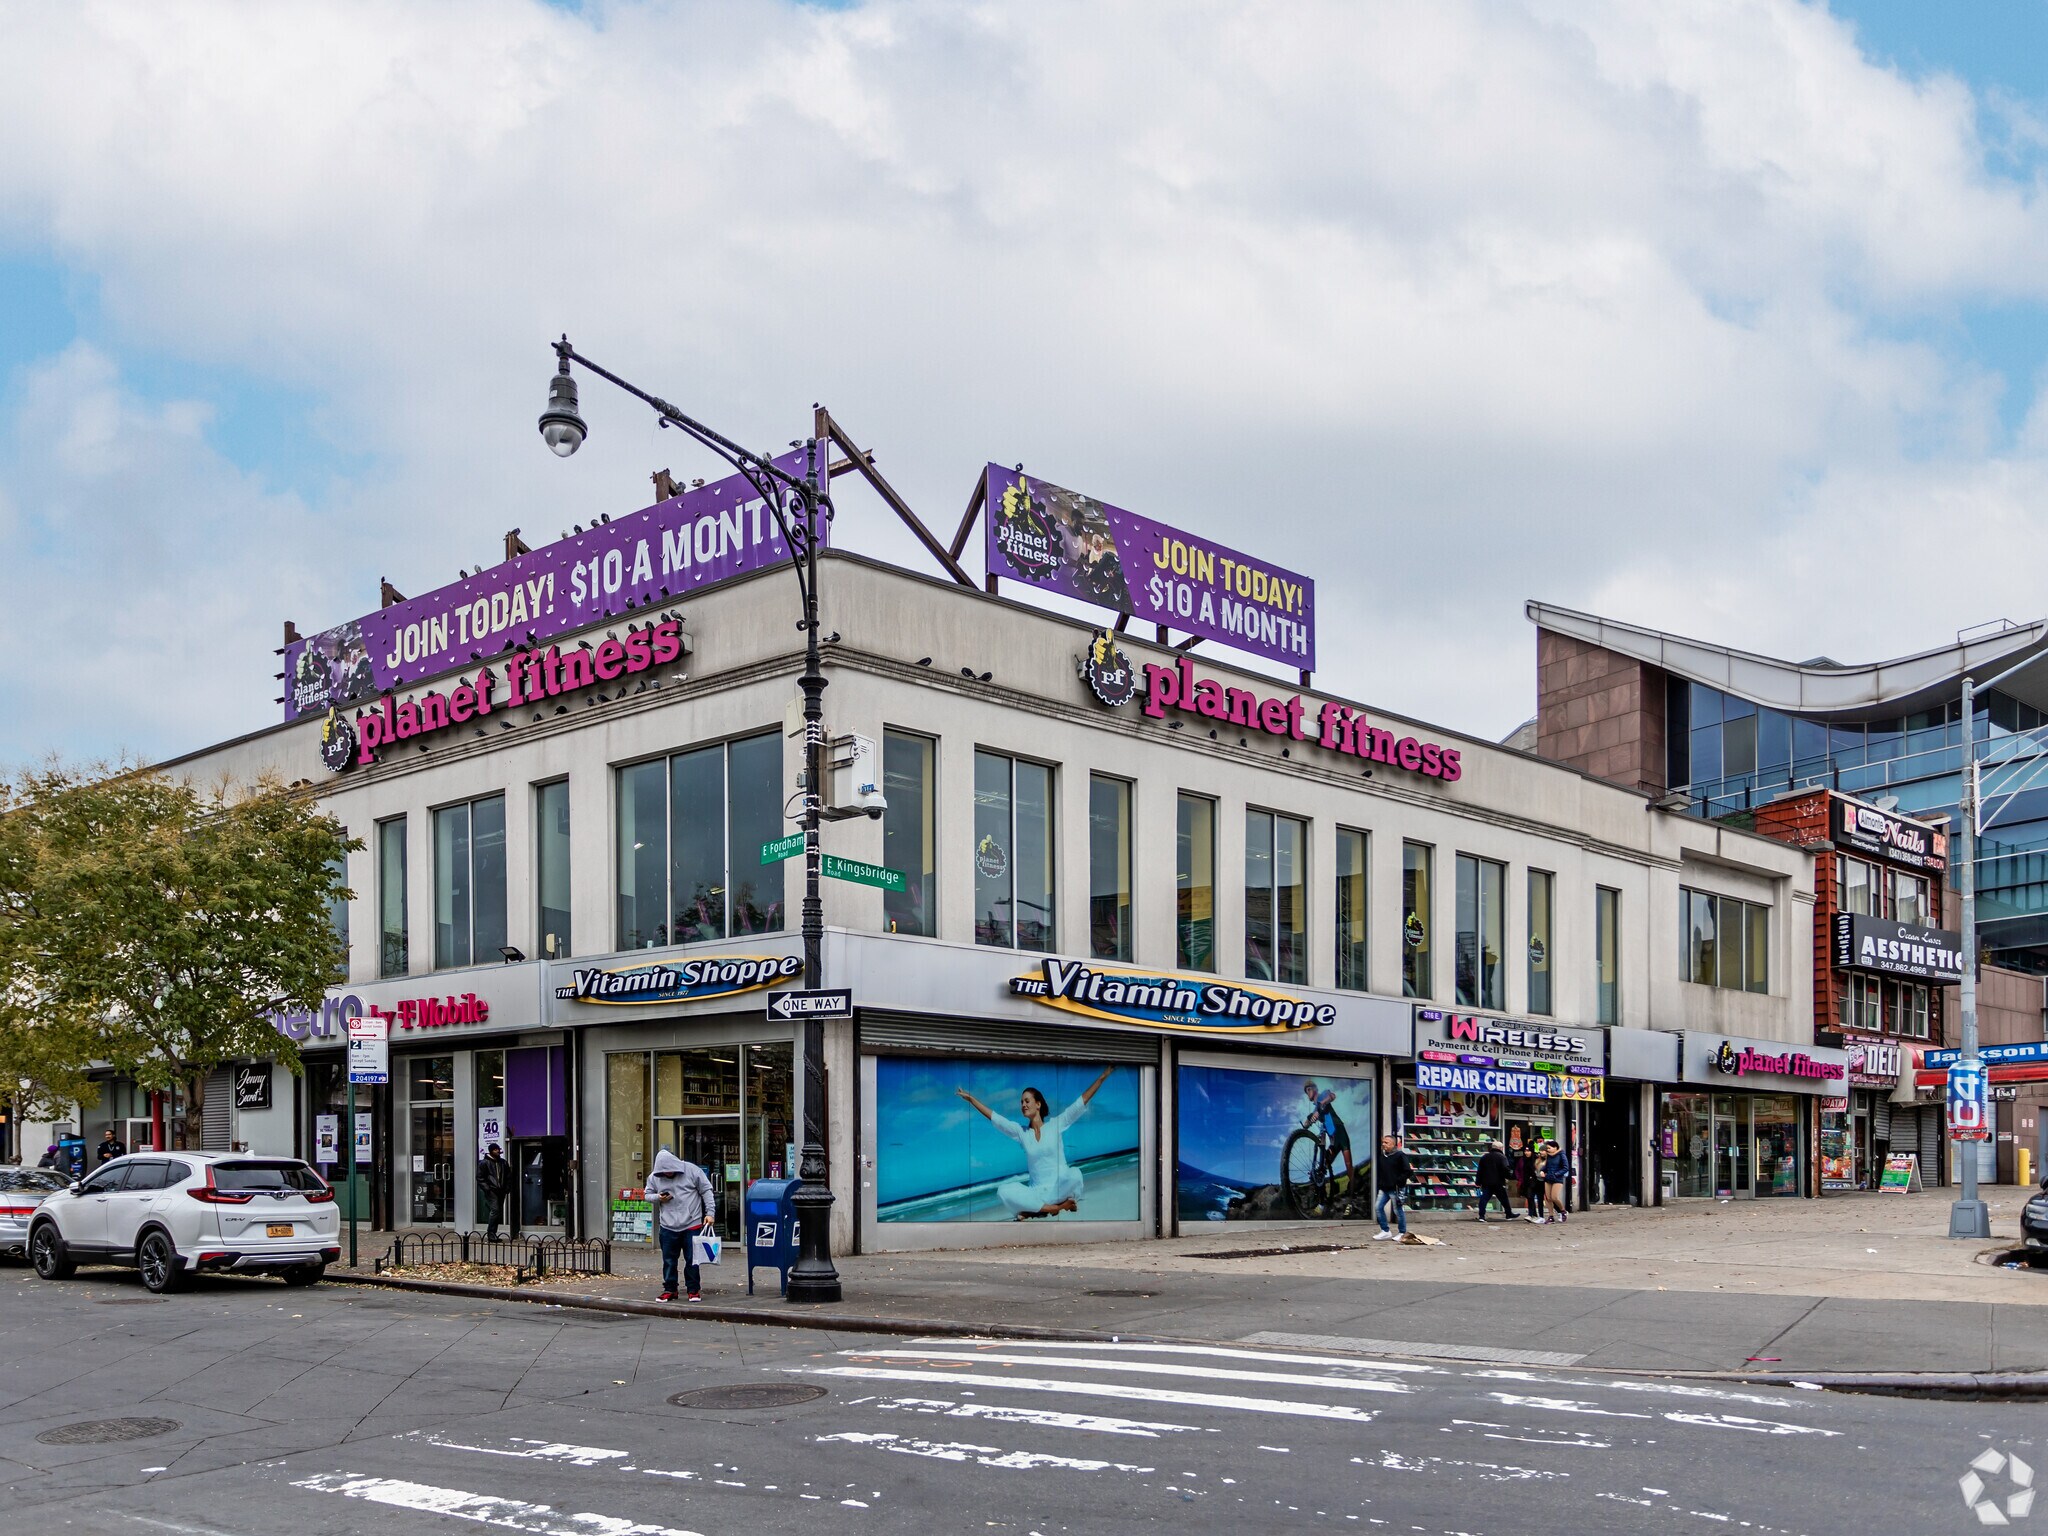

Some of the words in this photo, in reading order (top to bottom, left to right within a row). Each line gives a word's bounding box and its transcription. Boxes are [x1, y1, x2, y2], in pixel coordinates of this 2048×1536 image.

[999, 524, 1048, 550] planet
[1006, 539, 1057, 566] fitness
[387, 613, 448, 669] JOIN
[455, 573, 554, 644] TODAY!
[570, 548, 622, 607] $10
[631, 538, 654, 586] A
[662, 489, 796, 575] MONTH
[1153, 537, 1214, 585] JOIN
[1220, 557, 1303, 616] TODAY!
[1150, 573, 1193, 617] $10
[1199, 591, 1216, 626] A
[1221, 598, 1307, 655] MONTH
[294, 680, 323, 697] planet
[1101, 669, 1126, 686] pf
[298, 689, 329, 707] fitness
[358, 667, 496, 764] planet
[507, 620, 684, 708] fitness
[1144, 655, 1305, 741] planet
[1319, 701, 1462, 782] fitness
[327, 736, 344, 757] pf
[763, 845, 767, 856] E
[770, 834, 804, 854] Fordham
[1883, 820, 1925, 853] Nails
[778, 850, 788, 858] Road
[827, 857, 832, 869] E
[837, 859, 899, 884] Kingsbridge
[827, 869, 841, 877] Road
[1897, 926, 1920, 941] Ocean
[1921, 931, 1942, 945] Laser
[556, 987, 575, 998] THE
[574, 966, 676, 997] Vitamin
[680, 956, 798, 986] Shoppe
[783, 999, 808, 1011] ONE
[814, 997, 840, 1010] WAY
[1016, 979, 1048, 995] THE
[1046, 958, 1196, 1011] Vitamin
[1203, 987, 1336, 1027] Shoppe
[1162, 1014, 1185, 1022] SINCE
[352, 1040, 359, 1049] 2
[1452, 1014, 1587, 1052] WIRELESS
[1428, 1039, 1470, 1052] Payment
[1482, 1045, 1500, 1054] Cell
[1502, 1047, 1531, 1058] Phone
[1534, 1050, 1562, 1061] Repair
[1564, 1053, 1591, 1063] Center
[1738, 1047, 1790, 1077] planet
[1793, 1053, 1845, 1081] fitness
[1867, 1045, 1901, 1076] DELI
[236, 1068, 266, 1090] Jenny
[1419, 1065, 1481, 1089] REPAIR
[1484, 1073, 1547, 1095] CENTER
[1953, 1073, 1980, 1127] C4
[483, 1121, 498, 1133] $40
[73, 1147, 81, 1156] P
